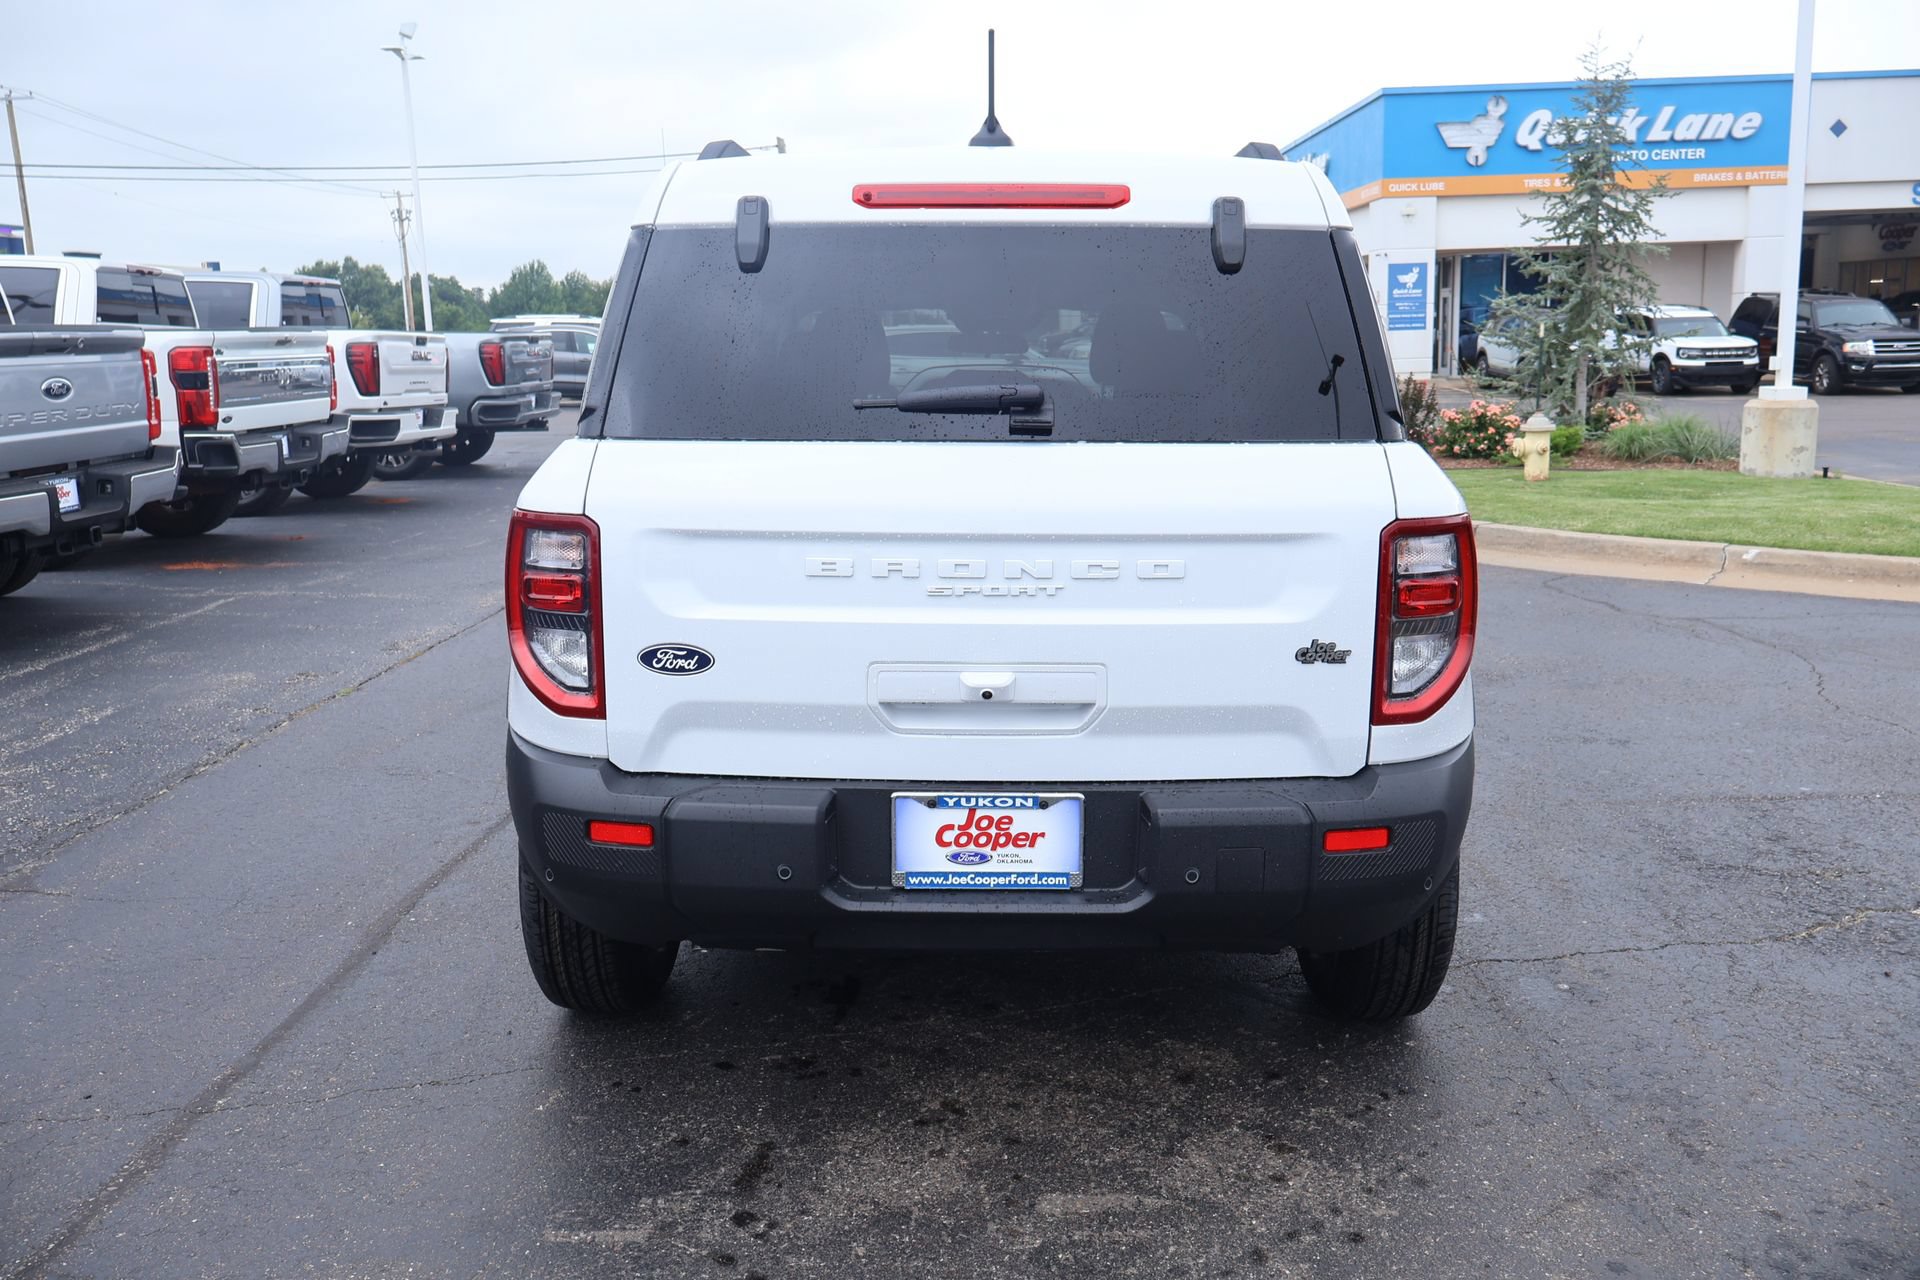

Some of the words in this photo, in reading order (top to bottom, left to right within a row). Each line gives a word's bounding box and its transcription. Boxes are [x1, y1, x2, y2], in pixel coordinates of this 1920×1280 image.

[1515, 108, 1649, 151] Quik
[1644, 105, 1763, 142] Lane
[1651, 148, 1706, 161] CENTER
[1523, 178, 1551, 188] TIRES
[1694, 172, 1733, 182] BRAKES
[1735, 172, 1742, 181] &
[1744, 170, 1788, 181] BATTERI
[1388, 183, 1418, 193] QUICK
[1420, 182, 1445, 191] LUBE
[0, 408, 68, 428] PER
[75, 402, 139, 421] DUTY
[804, 557, 1186, 580] BRONCO
[926, 585, 1065, 598] SPORT
[1308, 638, 1337, 653] Joe
[1295, 647, 1352, 663] Cooper
[943, 797, 1033, 808] YUKON
[957, 808, 1014, 832] Joe
[935, 824, 1046, 851] Cooper
[908, 873, 1067, 887] www.JoeCooperFord.com
